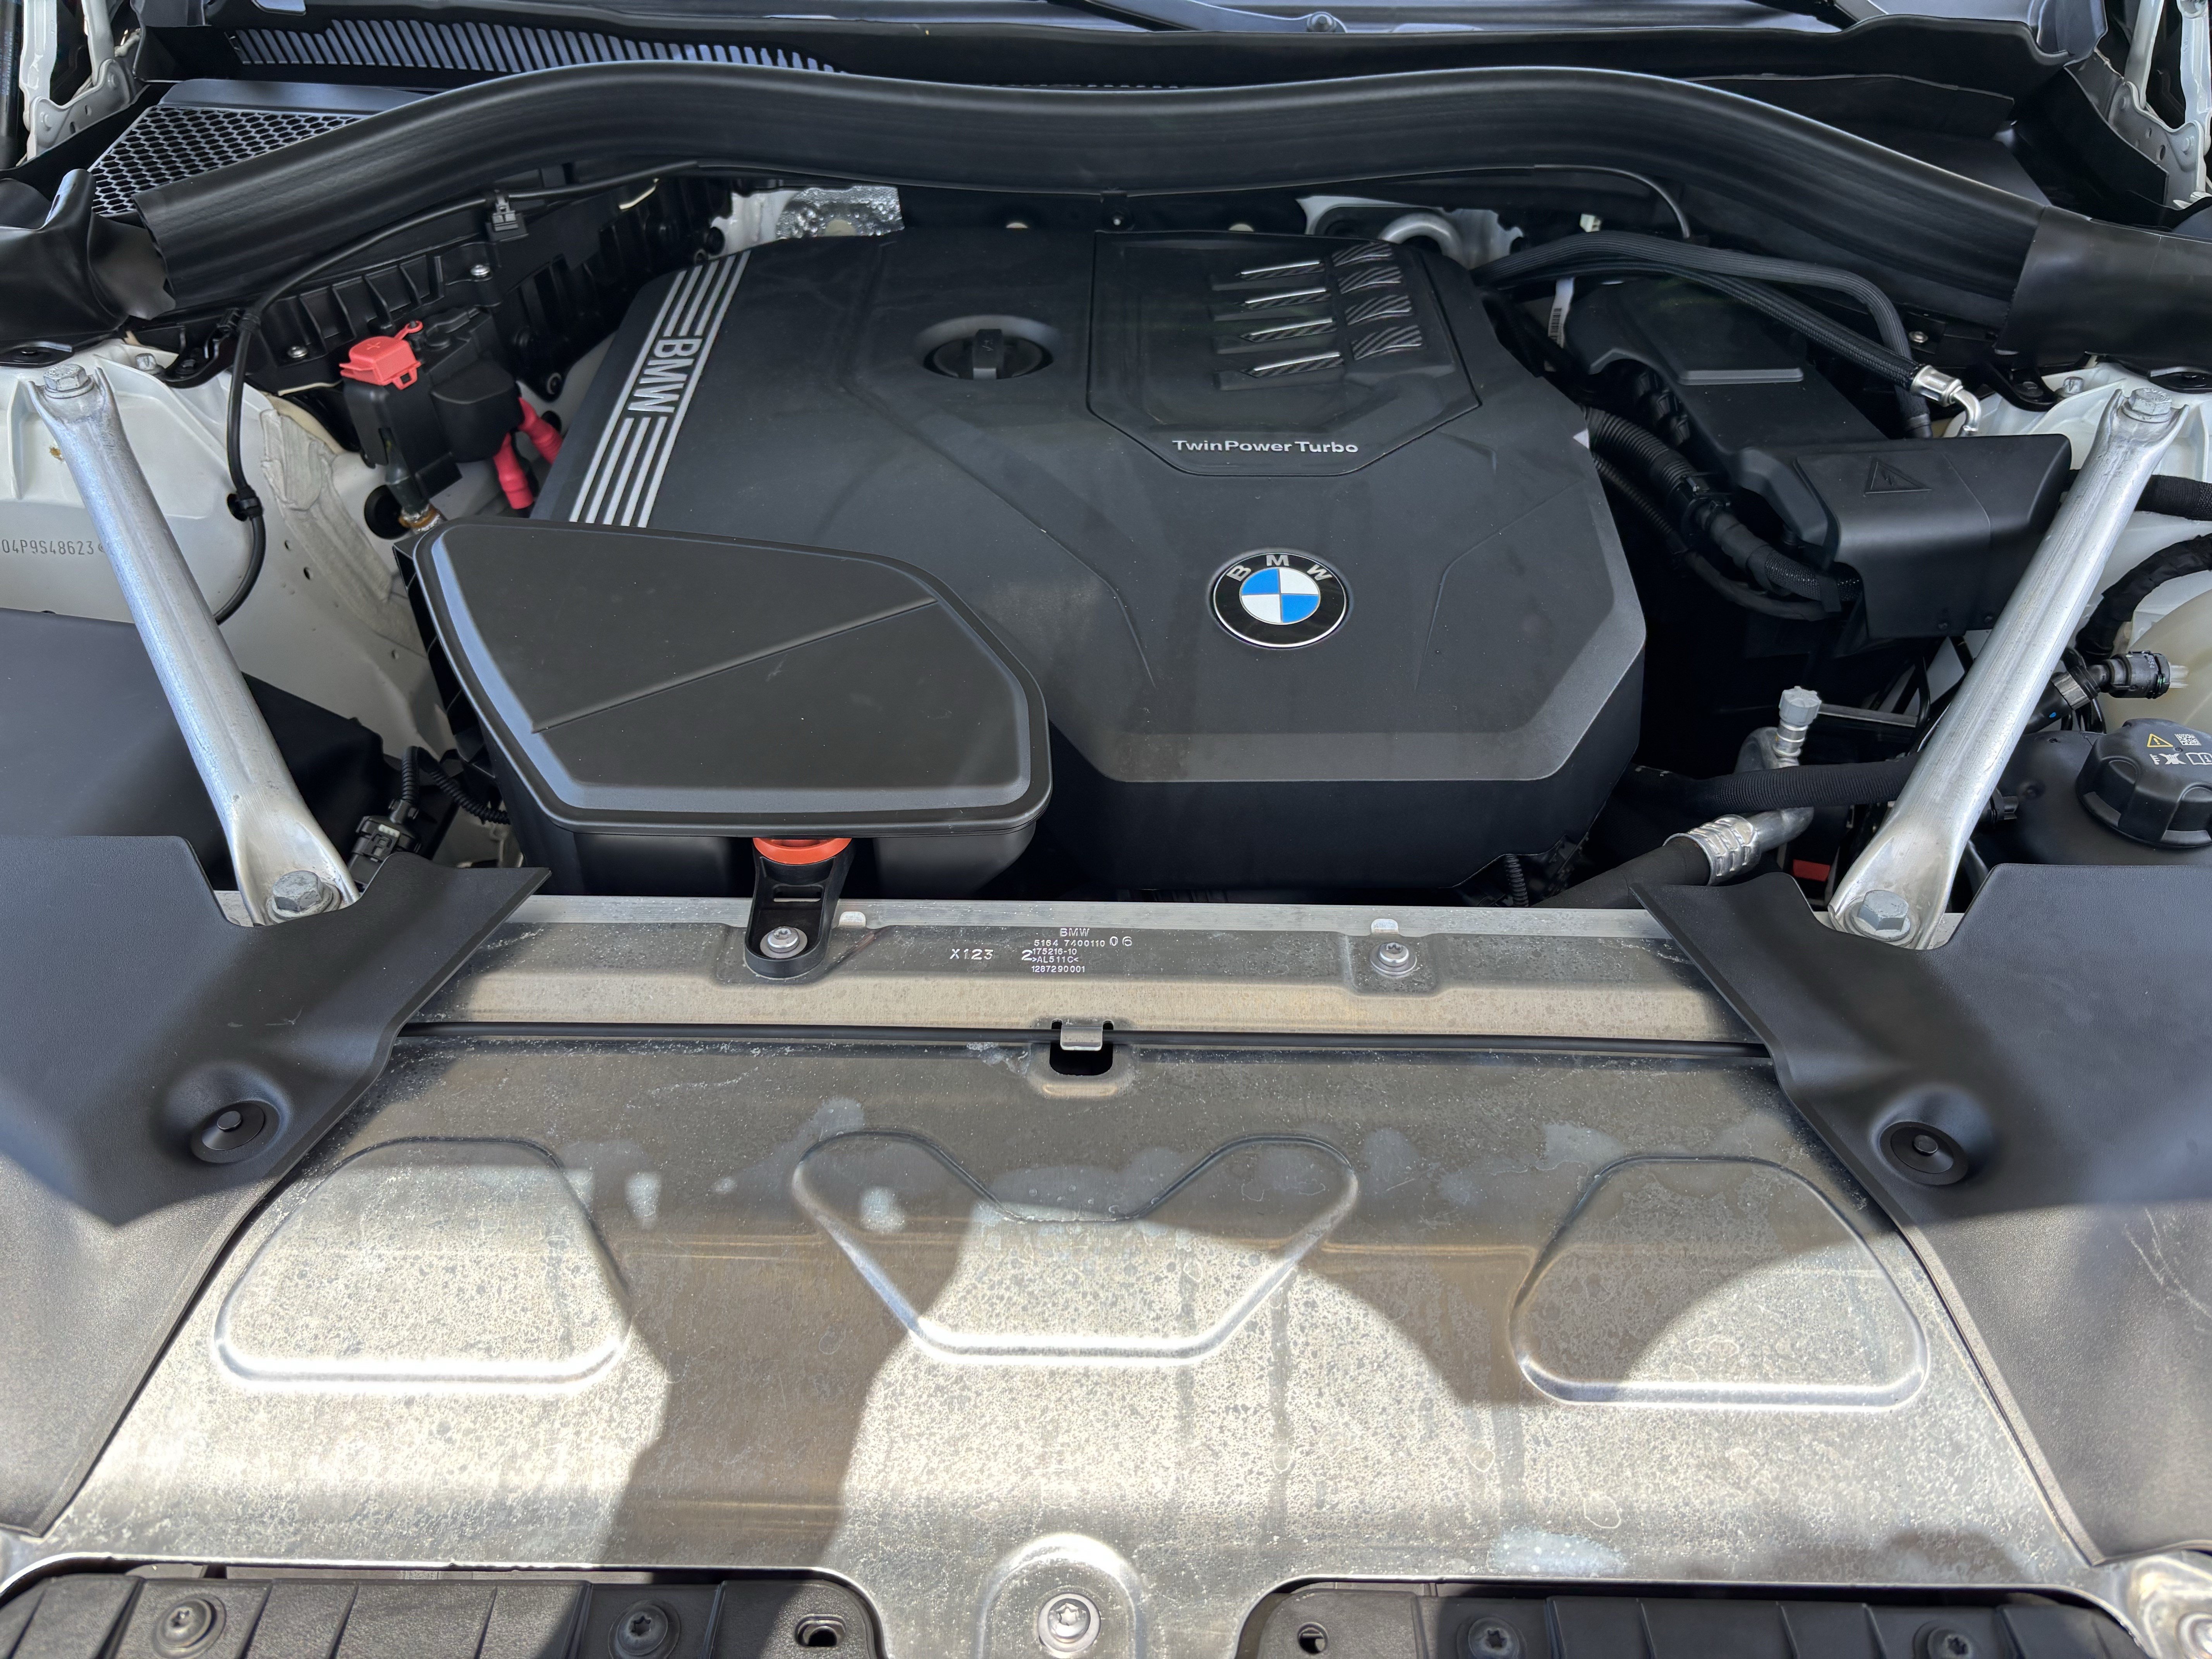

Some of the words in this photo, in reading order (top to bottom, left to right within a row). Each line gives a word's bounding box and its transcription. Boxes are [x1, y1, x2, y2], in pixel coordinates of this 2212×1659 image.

[627, 338, 703, 413] BMW
[1294, 441, 1358, 453] Turbo
[1226, 555, 1333, 582] BMW
[1060, 928, 1090, 937] BMW
[1064, 939, 1106, 947] 7400110
[950, 948, 994, 960] X123
